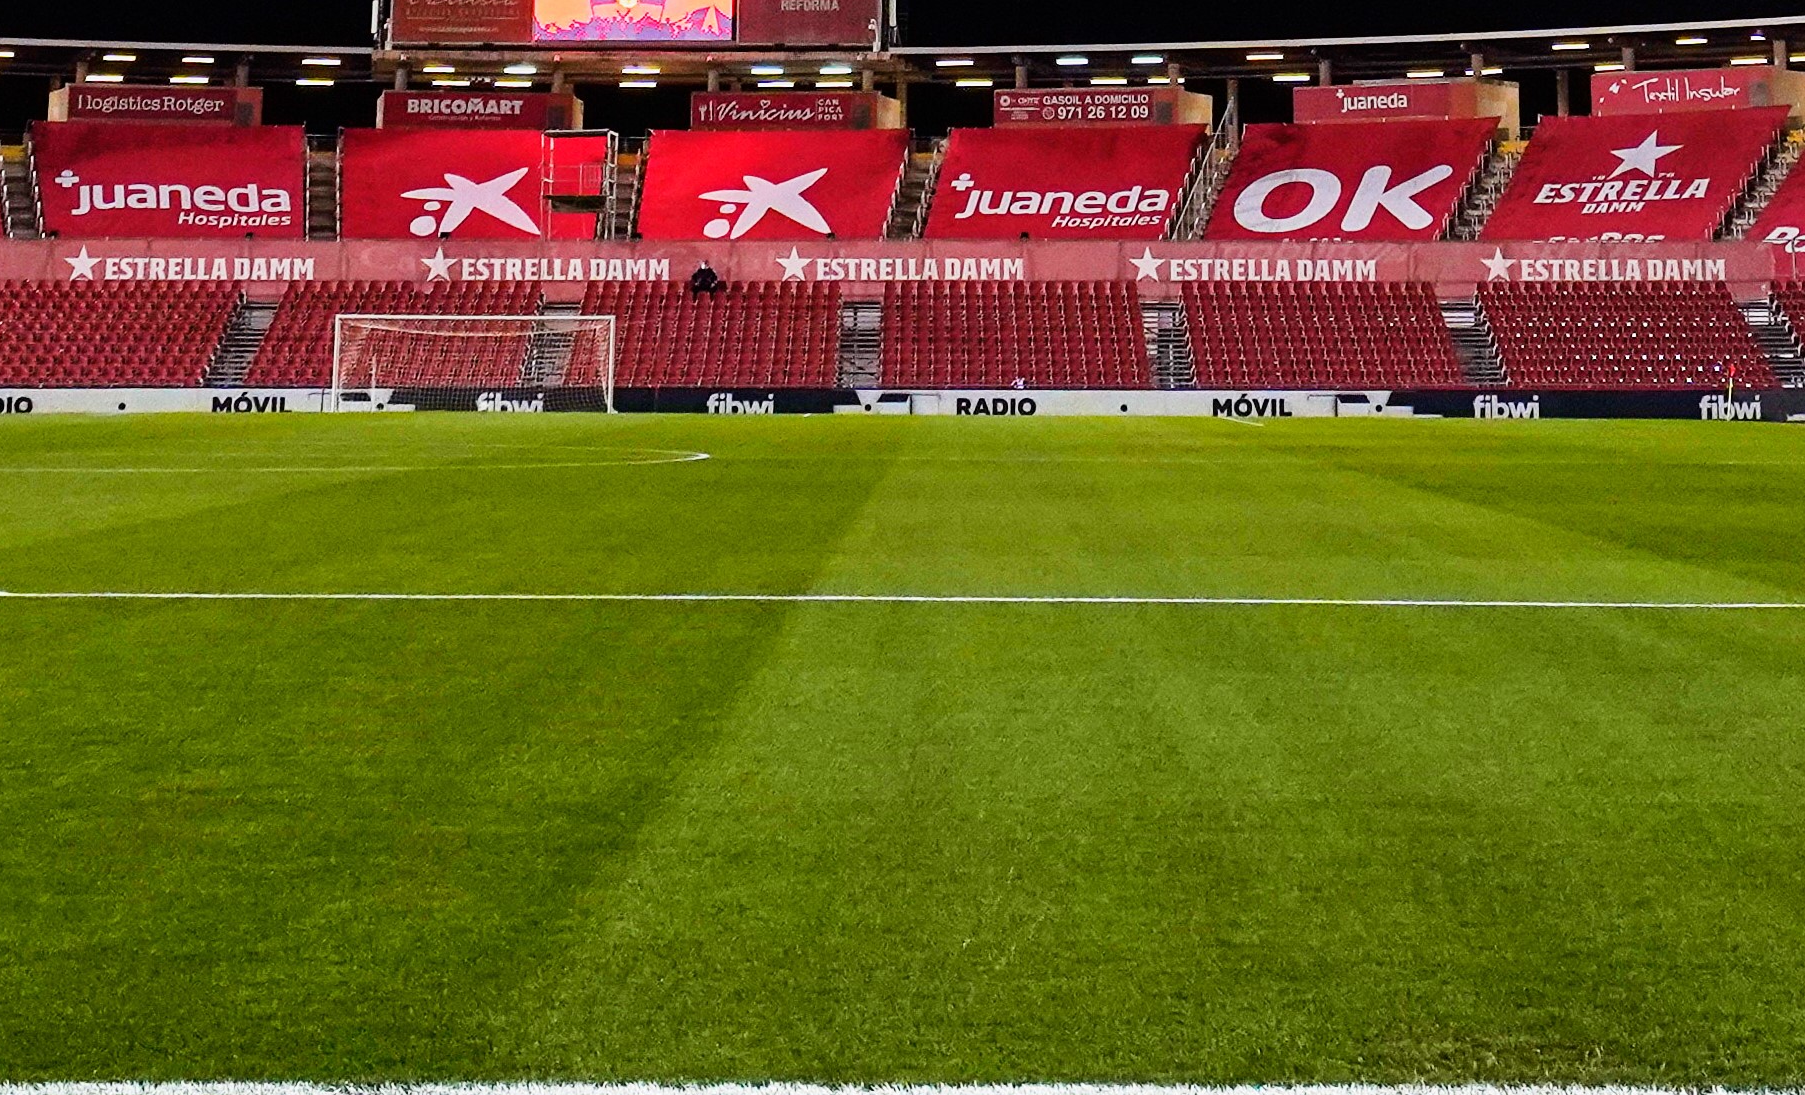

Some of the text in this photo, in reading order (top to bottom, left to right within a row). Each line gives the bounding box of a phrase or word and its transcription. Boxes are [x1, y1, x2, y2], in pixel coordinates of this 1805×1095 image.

[780, 0, 840, 11] REFORMA
[1042, 95, 1082, 105] GASOIL
[1084, 95, 1092, 105] A
[1095, 94, 1149, 104] DOMICILIO
[1631, 76, 1741, 103] Textil Insular
[406, 98, 524, 115] BRICOMART
[716, 99, 816, 121] Vinicius
[1057, 105, 1149, 120] 971 26 12 09
[1341, 92, 1408, 113] juaneda
[70, 183, 292, 216] juaneda
[954, 185, 1170, 220] juaneda
[1233, 165, 1454, 233] OK
[1532, 179, 1711, 205] ESTRELLA
[1581, 201, 1646, 214] DAMM
[178, 212, 292, 228] Hospitales
[1050, 214, 1162, 230] Hospitales
[104, 257, 316, 281] ESTRELLA DAMM
[461, 258, 671, 281] ESTRELLA DAMM
[815, 258, 1025, 281] ESTRELLA DAMM
[1169, 258, 1378, 282] ESTRELLA DAMM
[1520, 258, 1727, 282] ESTRELLA DAMM
[211, 392, 293, 413] MÓVIL
[476, 392, 545, 413] fibwi
[706, 392, 775, 414] fibwi
[956, 397, 1037, 416] RADIO
[1212, 393, 1293, 417] MÓVIL
[1472, 394, 1540, 419] fibwi
[1699, 394, 1762, 420] fibwi
